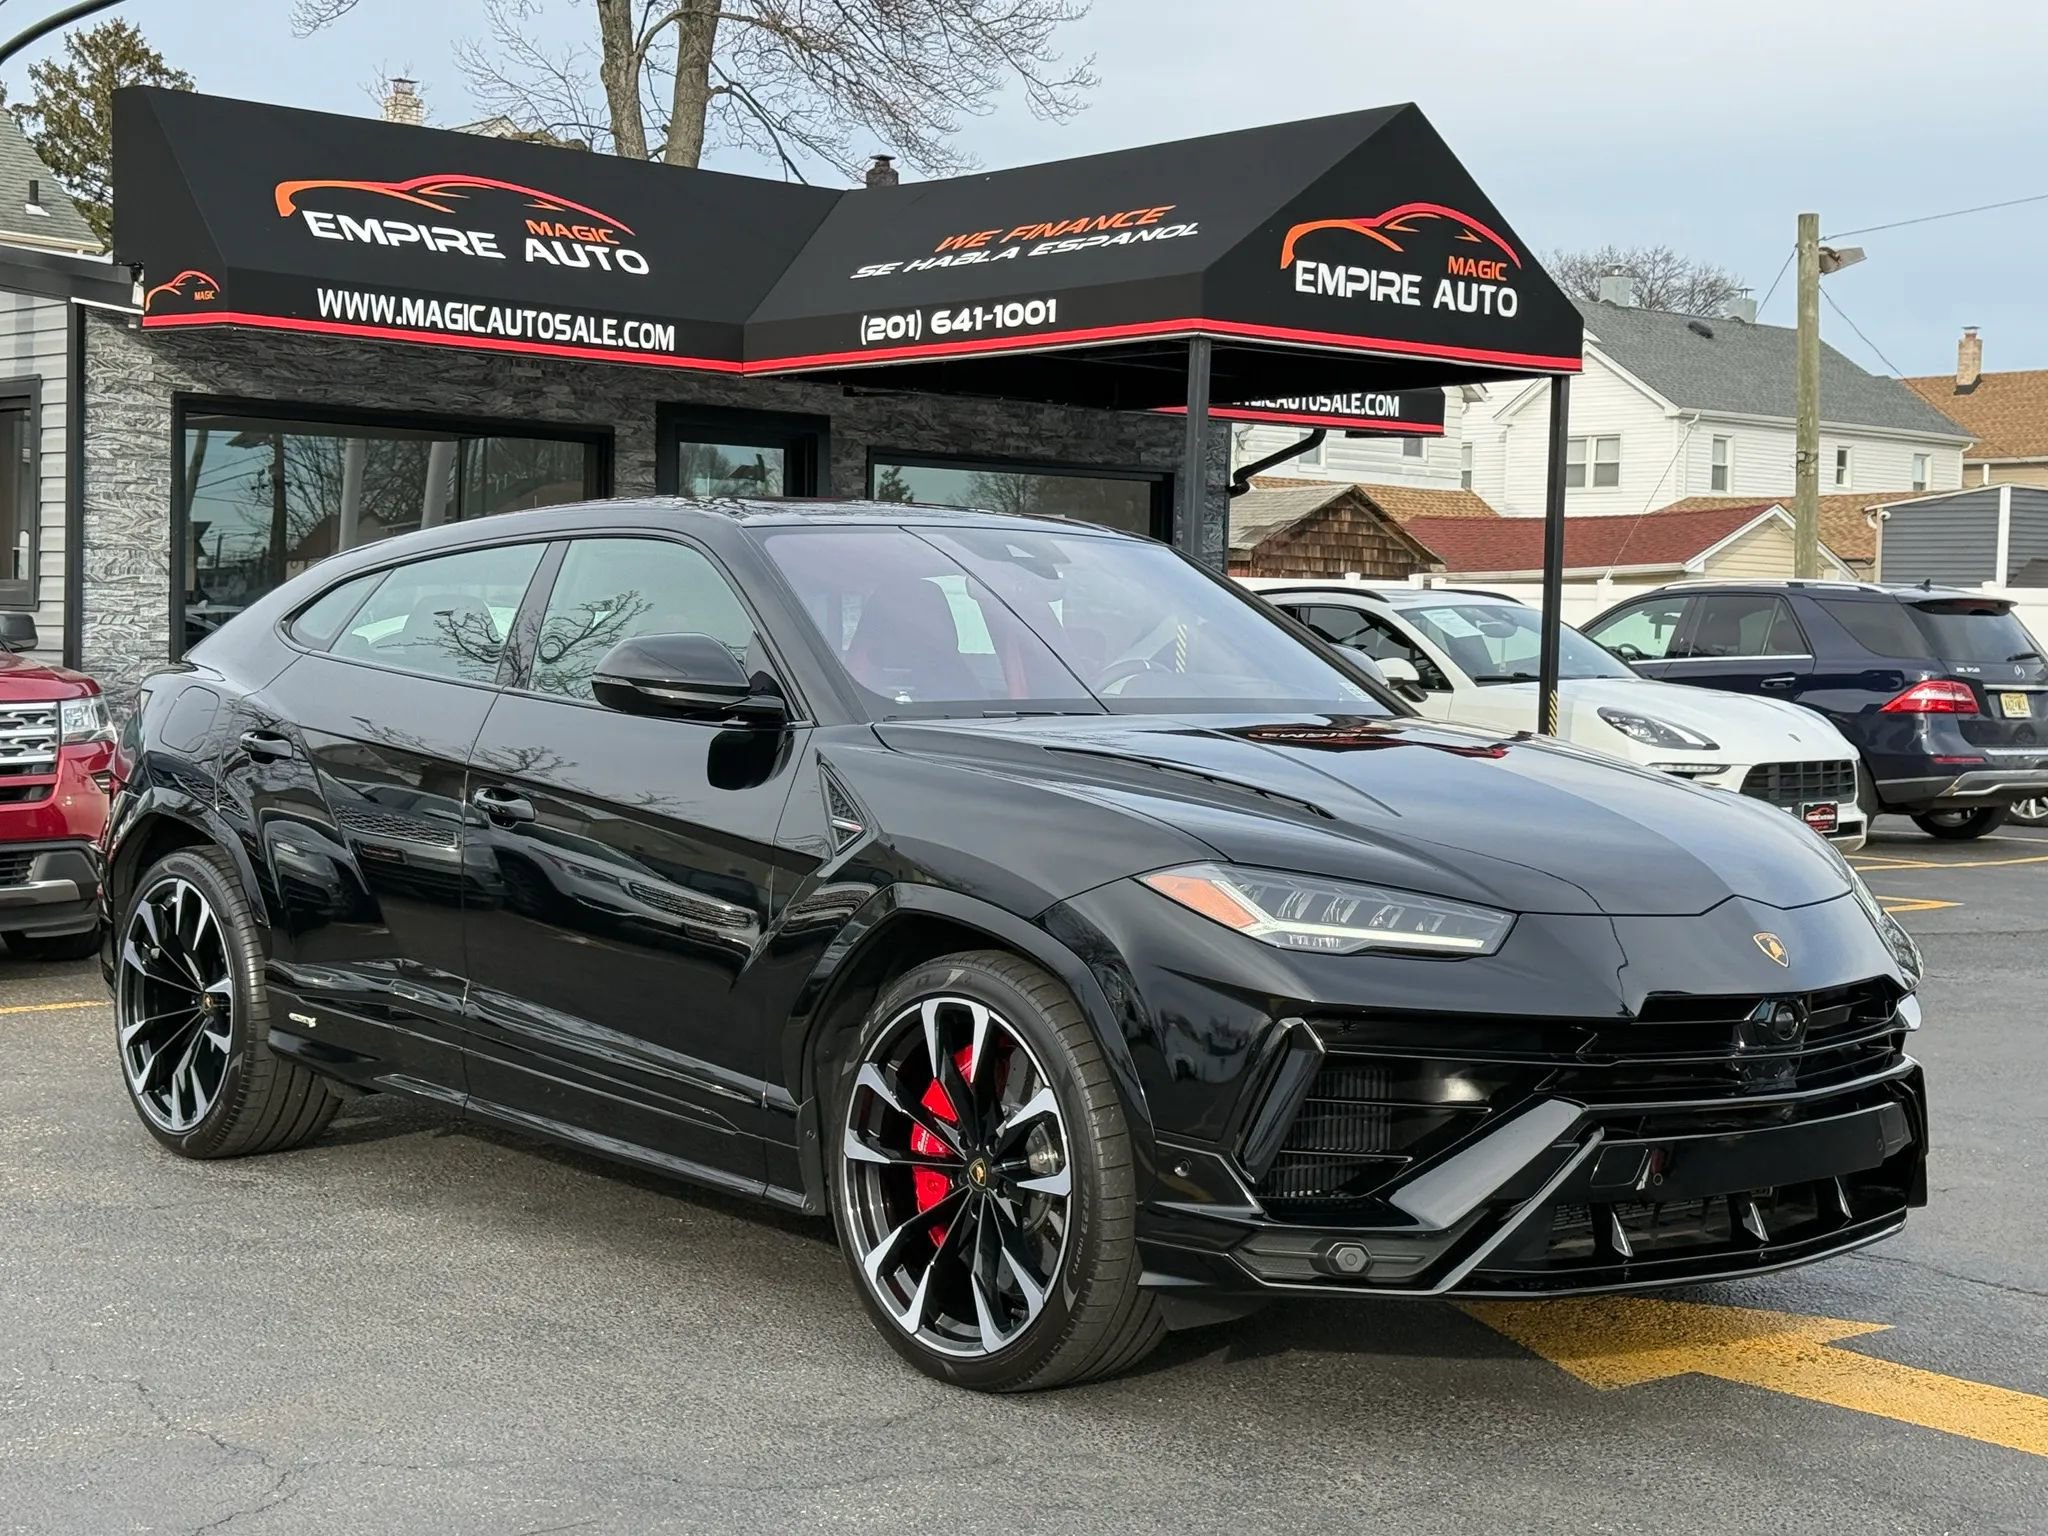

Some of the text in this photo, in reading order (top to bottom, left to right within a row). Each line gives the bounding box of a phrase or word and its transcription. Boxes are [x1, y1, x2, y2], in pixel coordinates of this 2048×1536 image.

[301, 209, 651, 276] EMPIRE AUTO
[525, 218, 622, 246] MAGIC
[850, 222, 1200, 280] SE HABLA ESPANOL
[934, 205, 1177, 252] WE FINANCE
[1294, 260, 1519, 318] EMPIRE AUTO
[1448, 255, 1510, 282] MAGIC
[194, 290, 217, 301] MAGIC
[315, 287, 675, 352] WWW.MAGICAUTOSALE.COM
[859, 298, 1058, 346] (201) 641-1001
